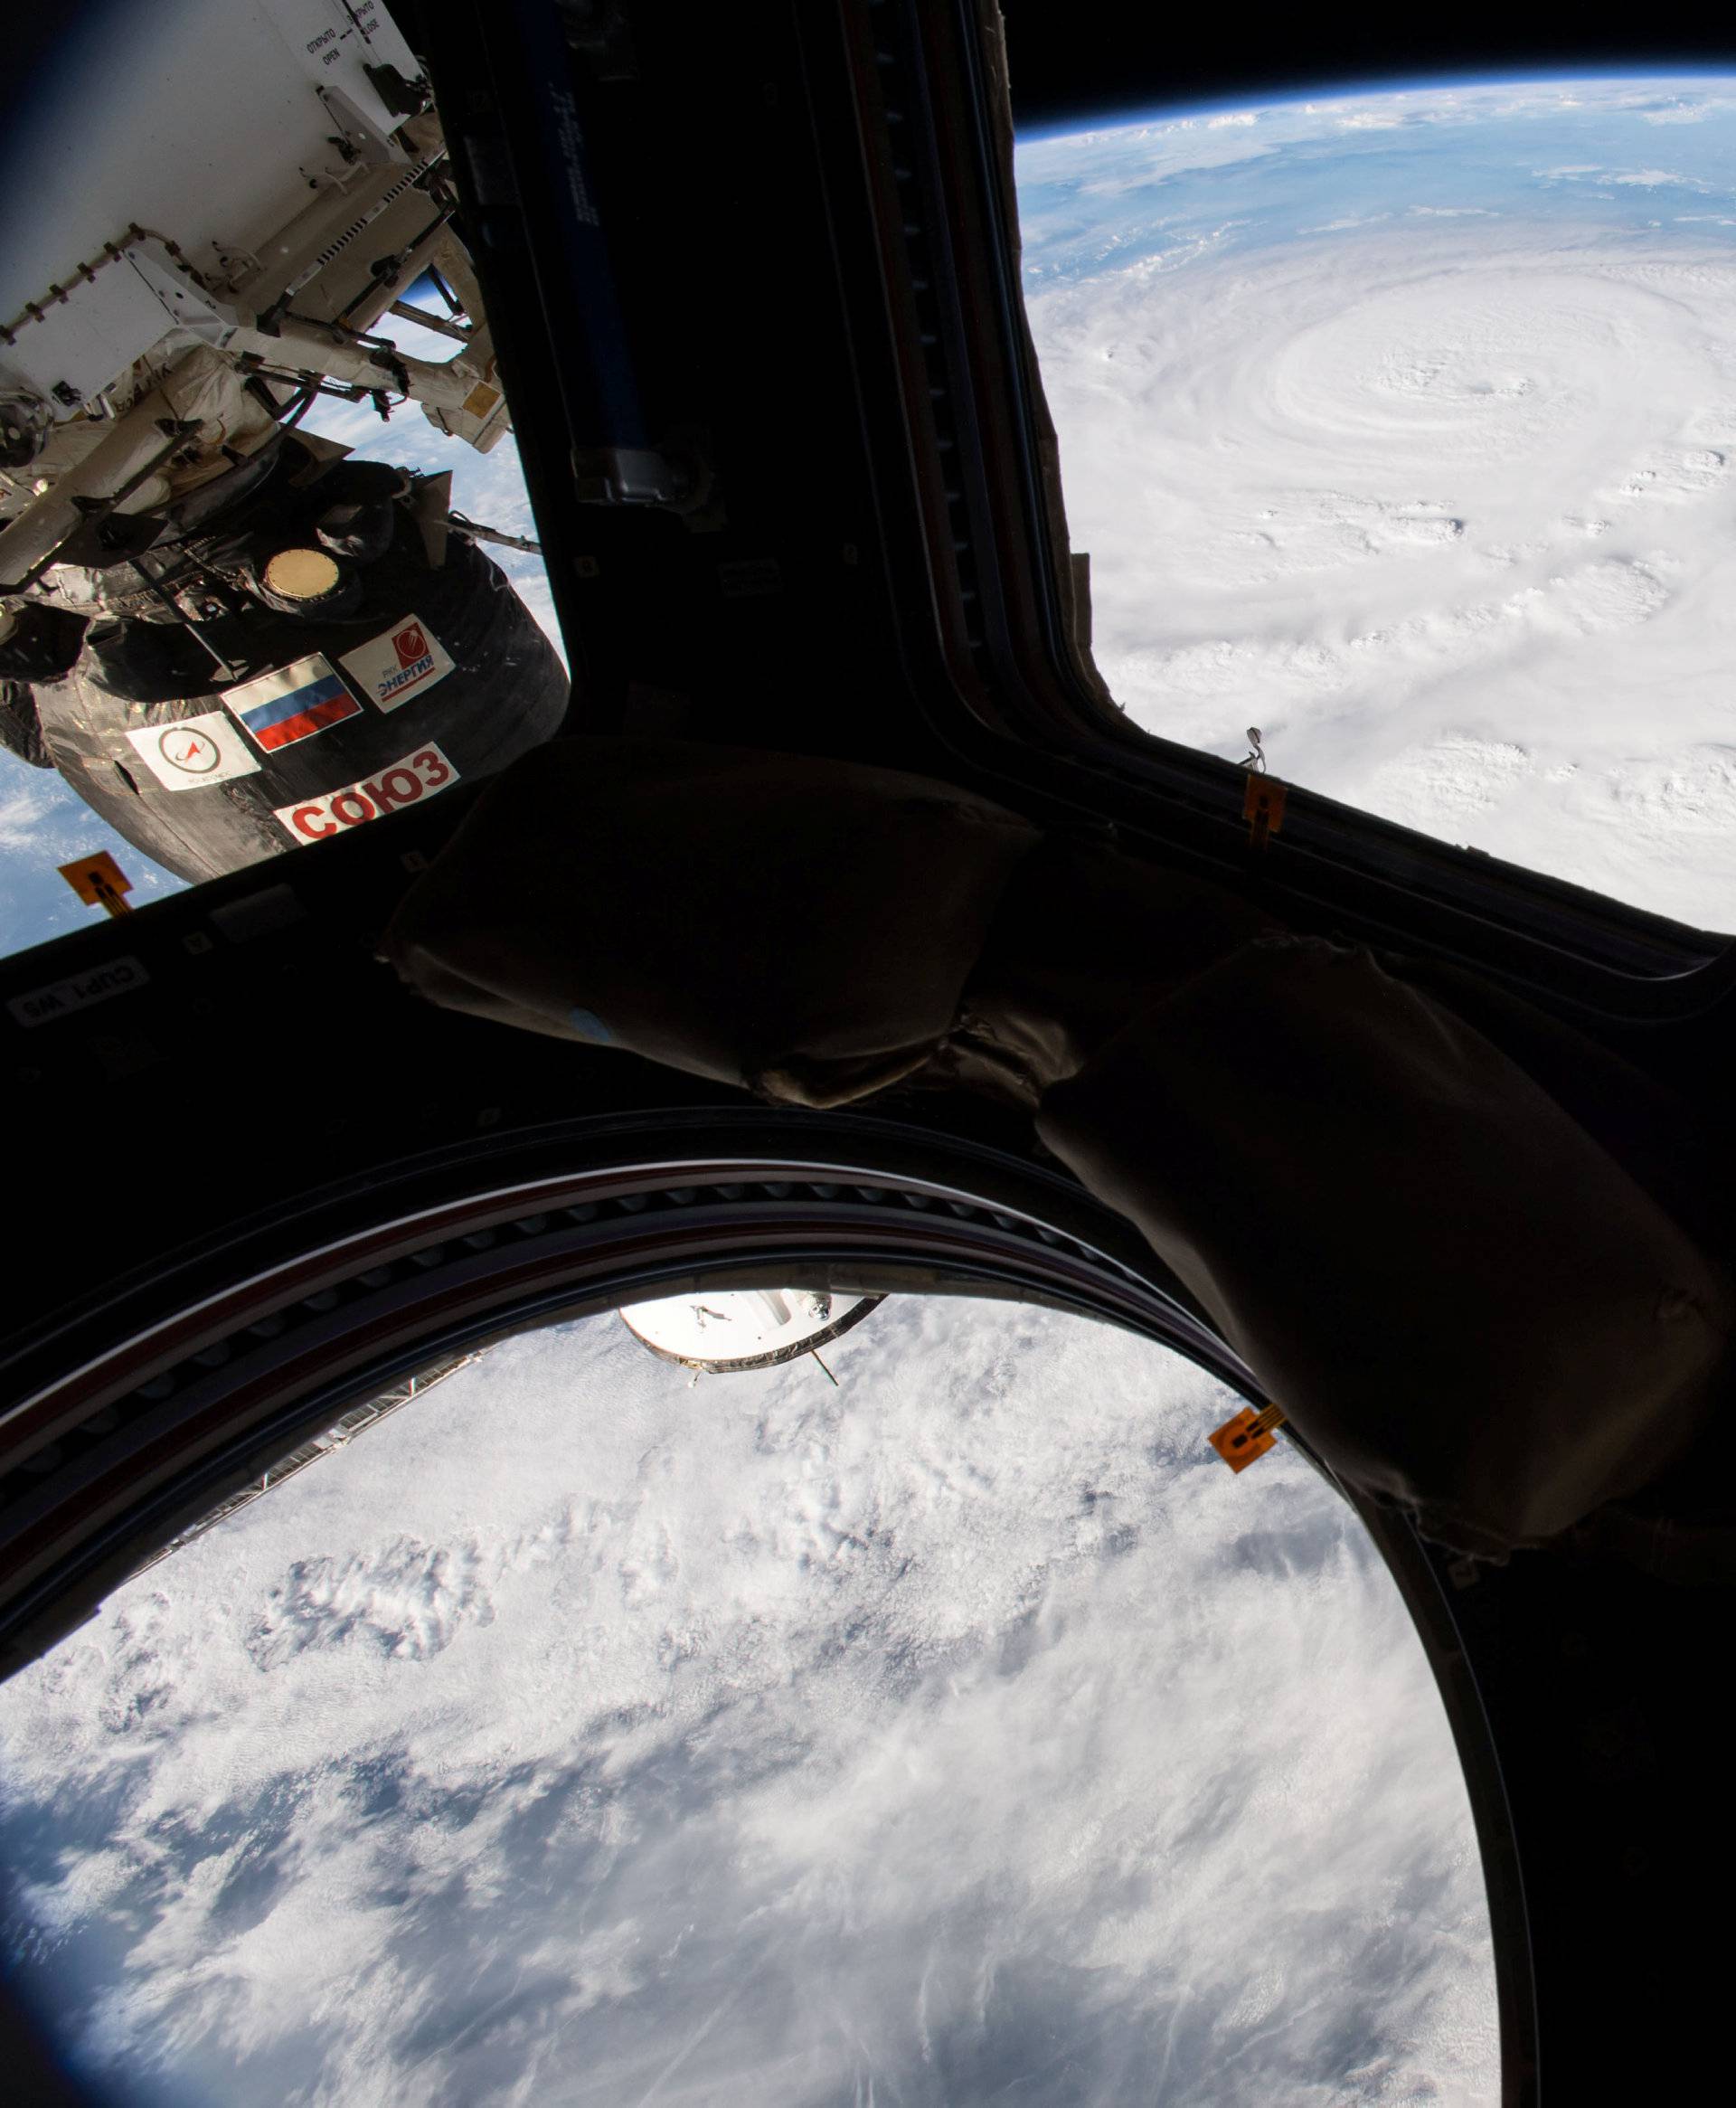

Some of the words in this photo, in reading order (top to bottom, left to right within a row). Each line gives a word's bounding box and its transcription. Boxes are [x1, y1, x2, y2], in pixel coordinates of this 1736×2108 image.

[347, 1, 374, 24] ЗКРЫТО
[363, 18, 380, 34] LOSE
[307, 28, 336, 54] ОТКРЫТО
[322, 48, 341, 66] OPEN
[377, 654, 435, 696] ЭНЕРГИЯ
[292, 750, 450, 840] СОЮЗ
